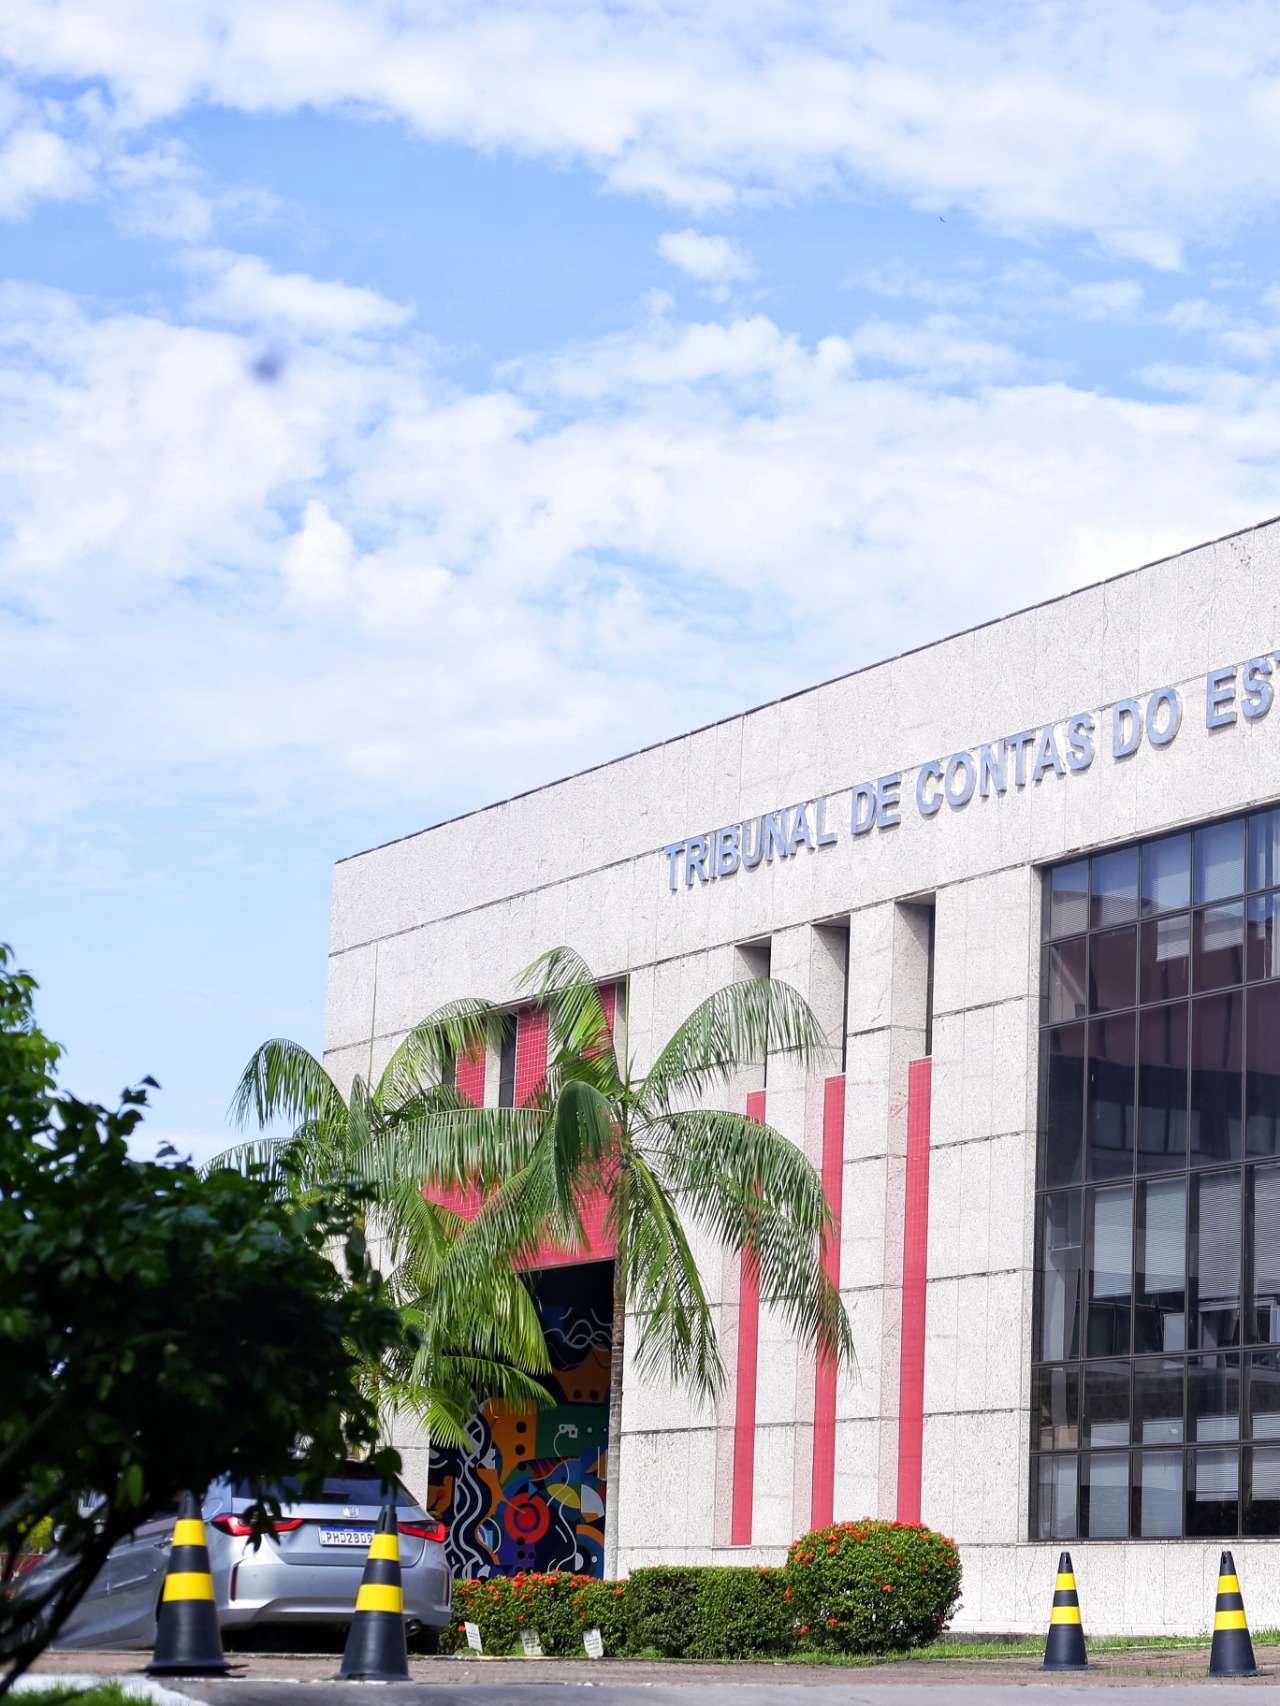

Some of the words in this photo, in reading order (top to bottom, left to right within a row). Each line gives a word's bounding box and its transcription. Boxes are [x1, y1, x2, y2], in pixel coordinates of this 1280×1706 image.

[664, 796, 837, 890] TRIBUNAL
[850, 773, 901, 836] DE
[915, 713, 1096, 816] CONTAS
[1112, 686, 1183, 759] DO
